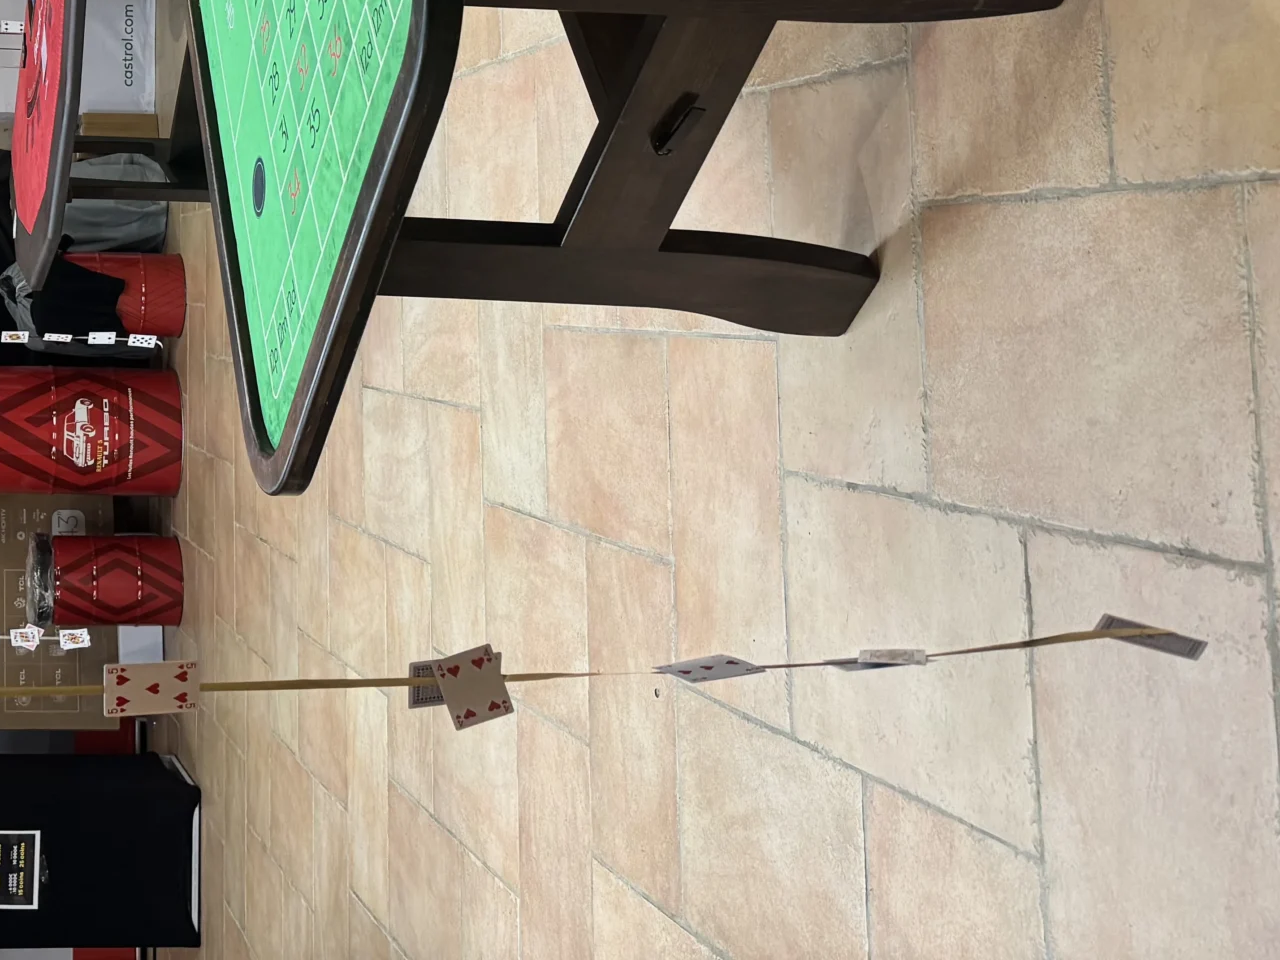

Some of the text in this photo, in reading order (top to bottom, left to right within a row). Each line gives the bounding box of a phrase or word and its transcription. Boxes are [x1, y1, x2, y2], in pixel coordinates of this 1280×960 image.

[121, 4, 134, 87] castrol.com
[328, 24, 342, 77] 36
[359, 31, 374, 75] 12d
[268, 61, 280, 106] 28
[278, 114, 289, 153] 31
[306, 96, 321, 149] 35
[102, 398, 110, 468] TURBO
